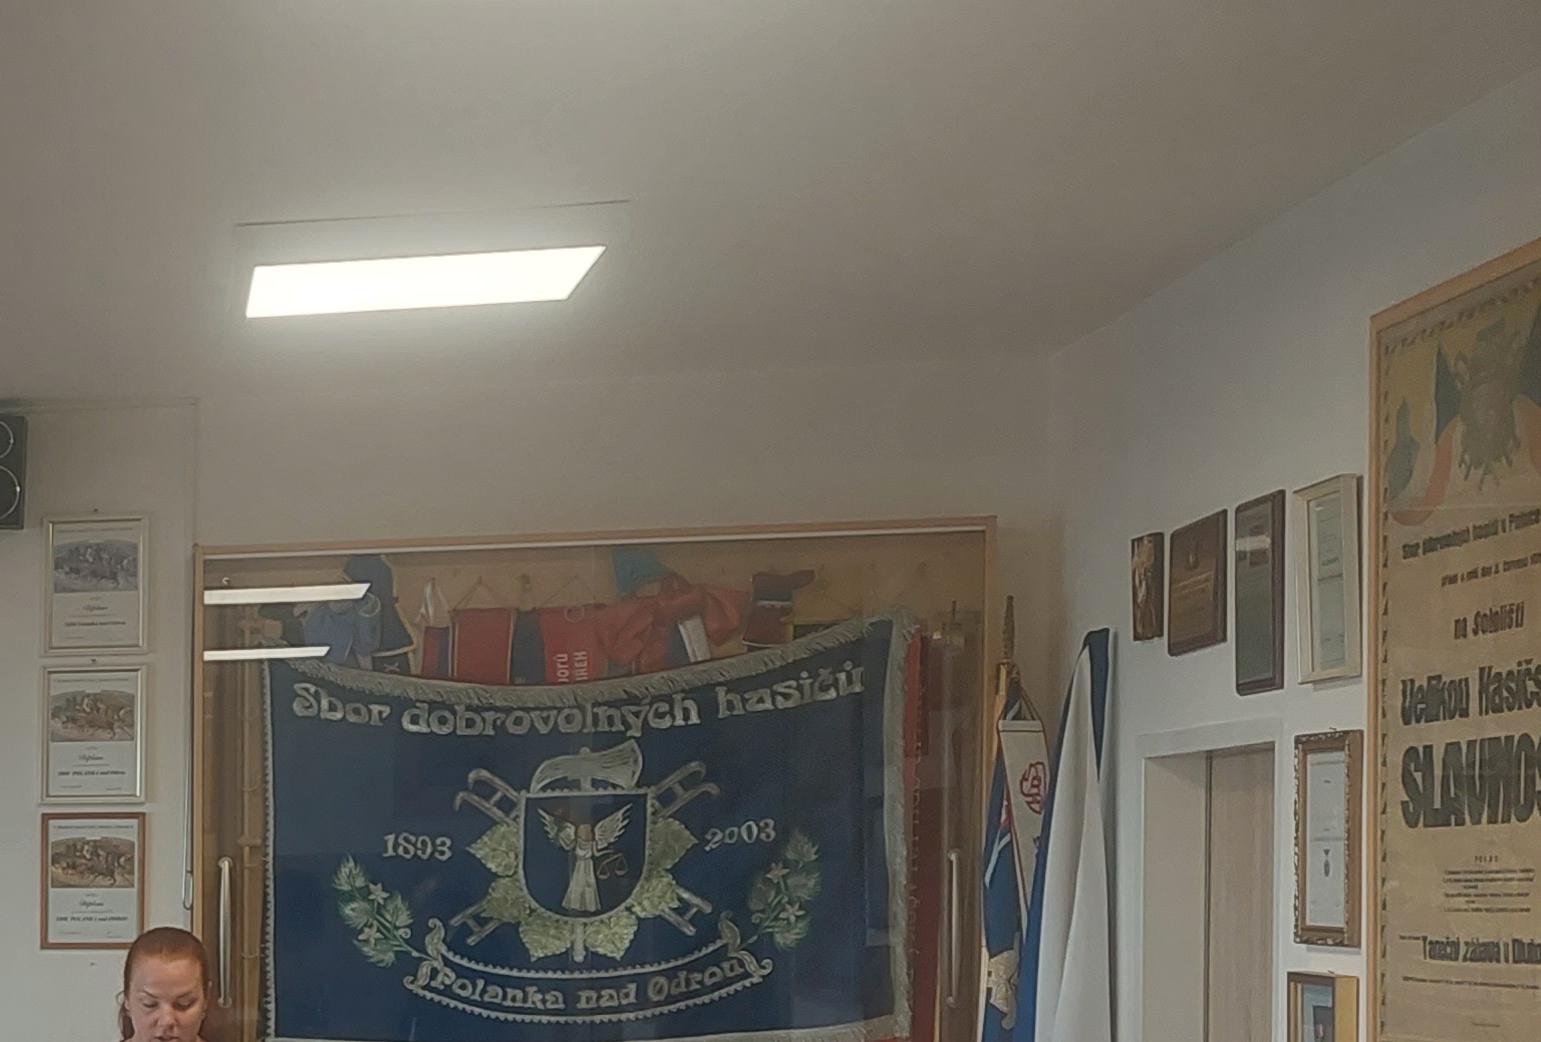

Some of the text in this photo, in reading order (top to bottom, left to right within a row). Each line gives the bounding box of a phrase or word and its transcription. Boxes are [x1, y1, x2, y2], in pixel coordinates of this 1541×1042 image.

[292, 662, 866, 740] Sbor dobrovolných hasičů
[382, 819, 777, 861] 1893 2003
[431, 955, 745, 1011] Polanka nad Odrou
